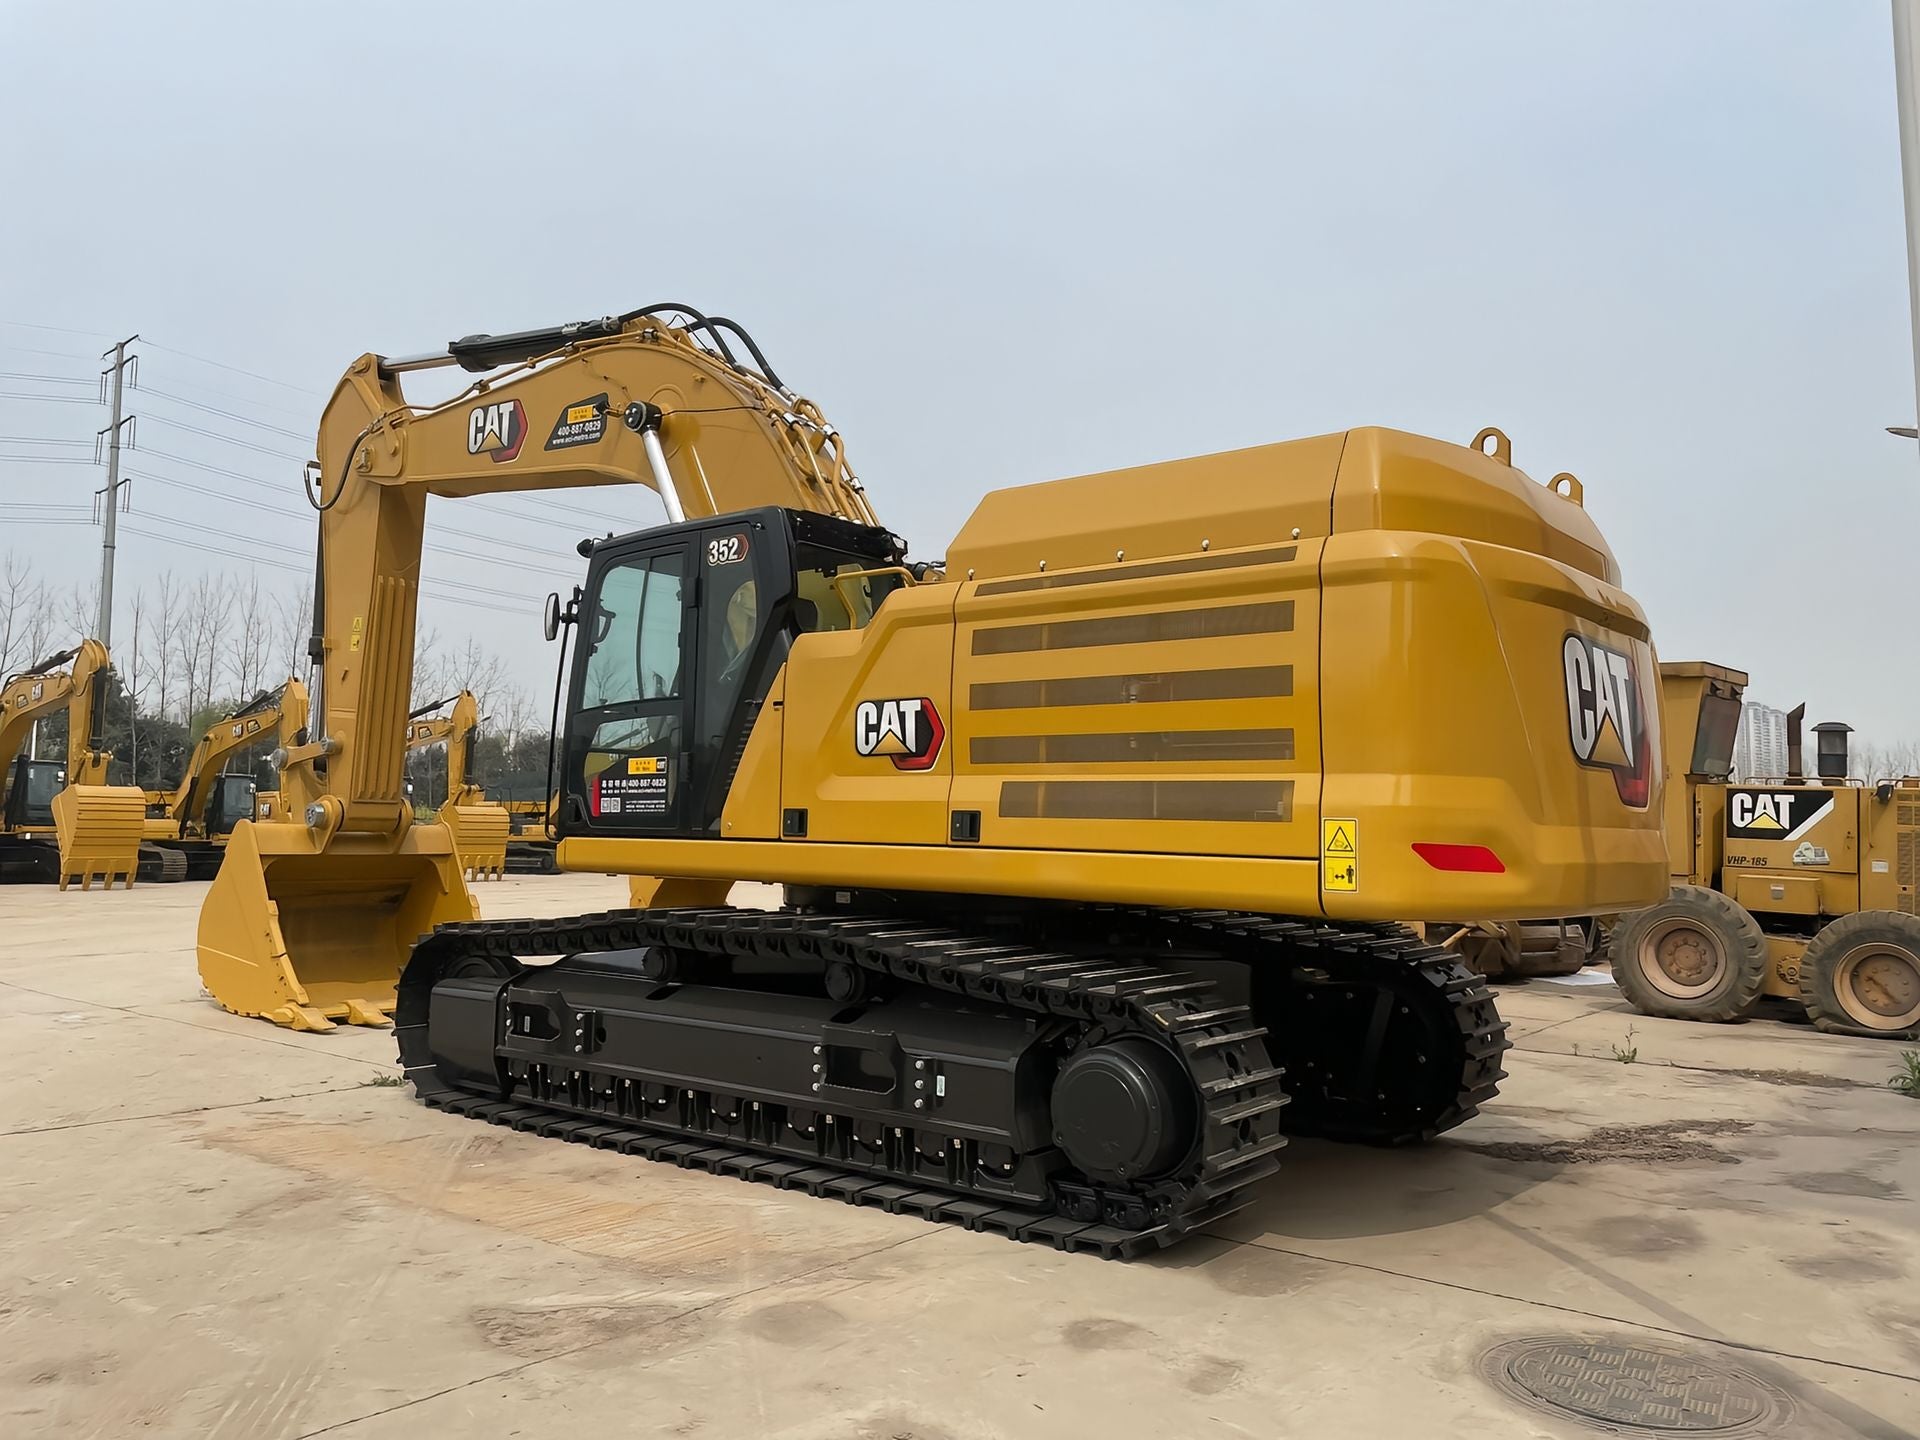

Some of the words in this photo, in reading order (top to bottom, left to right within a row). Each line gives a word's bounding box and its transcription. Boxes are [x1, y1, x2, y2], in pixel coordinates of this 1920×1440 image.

[468, 401, 515, 454] CAT
[557, 420, 602, 436] 400-887-0829
[709, 537, 739, 563] 352
[1564, 636, 1634, 768] CAT
[856, 699, 922, 756] CAT
[628, 779, 666, 788] 400-887-0829
[1731, 792, 1795, 830] CAT
[1726, 855, 1768, 867] VHP-185
